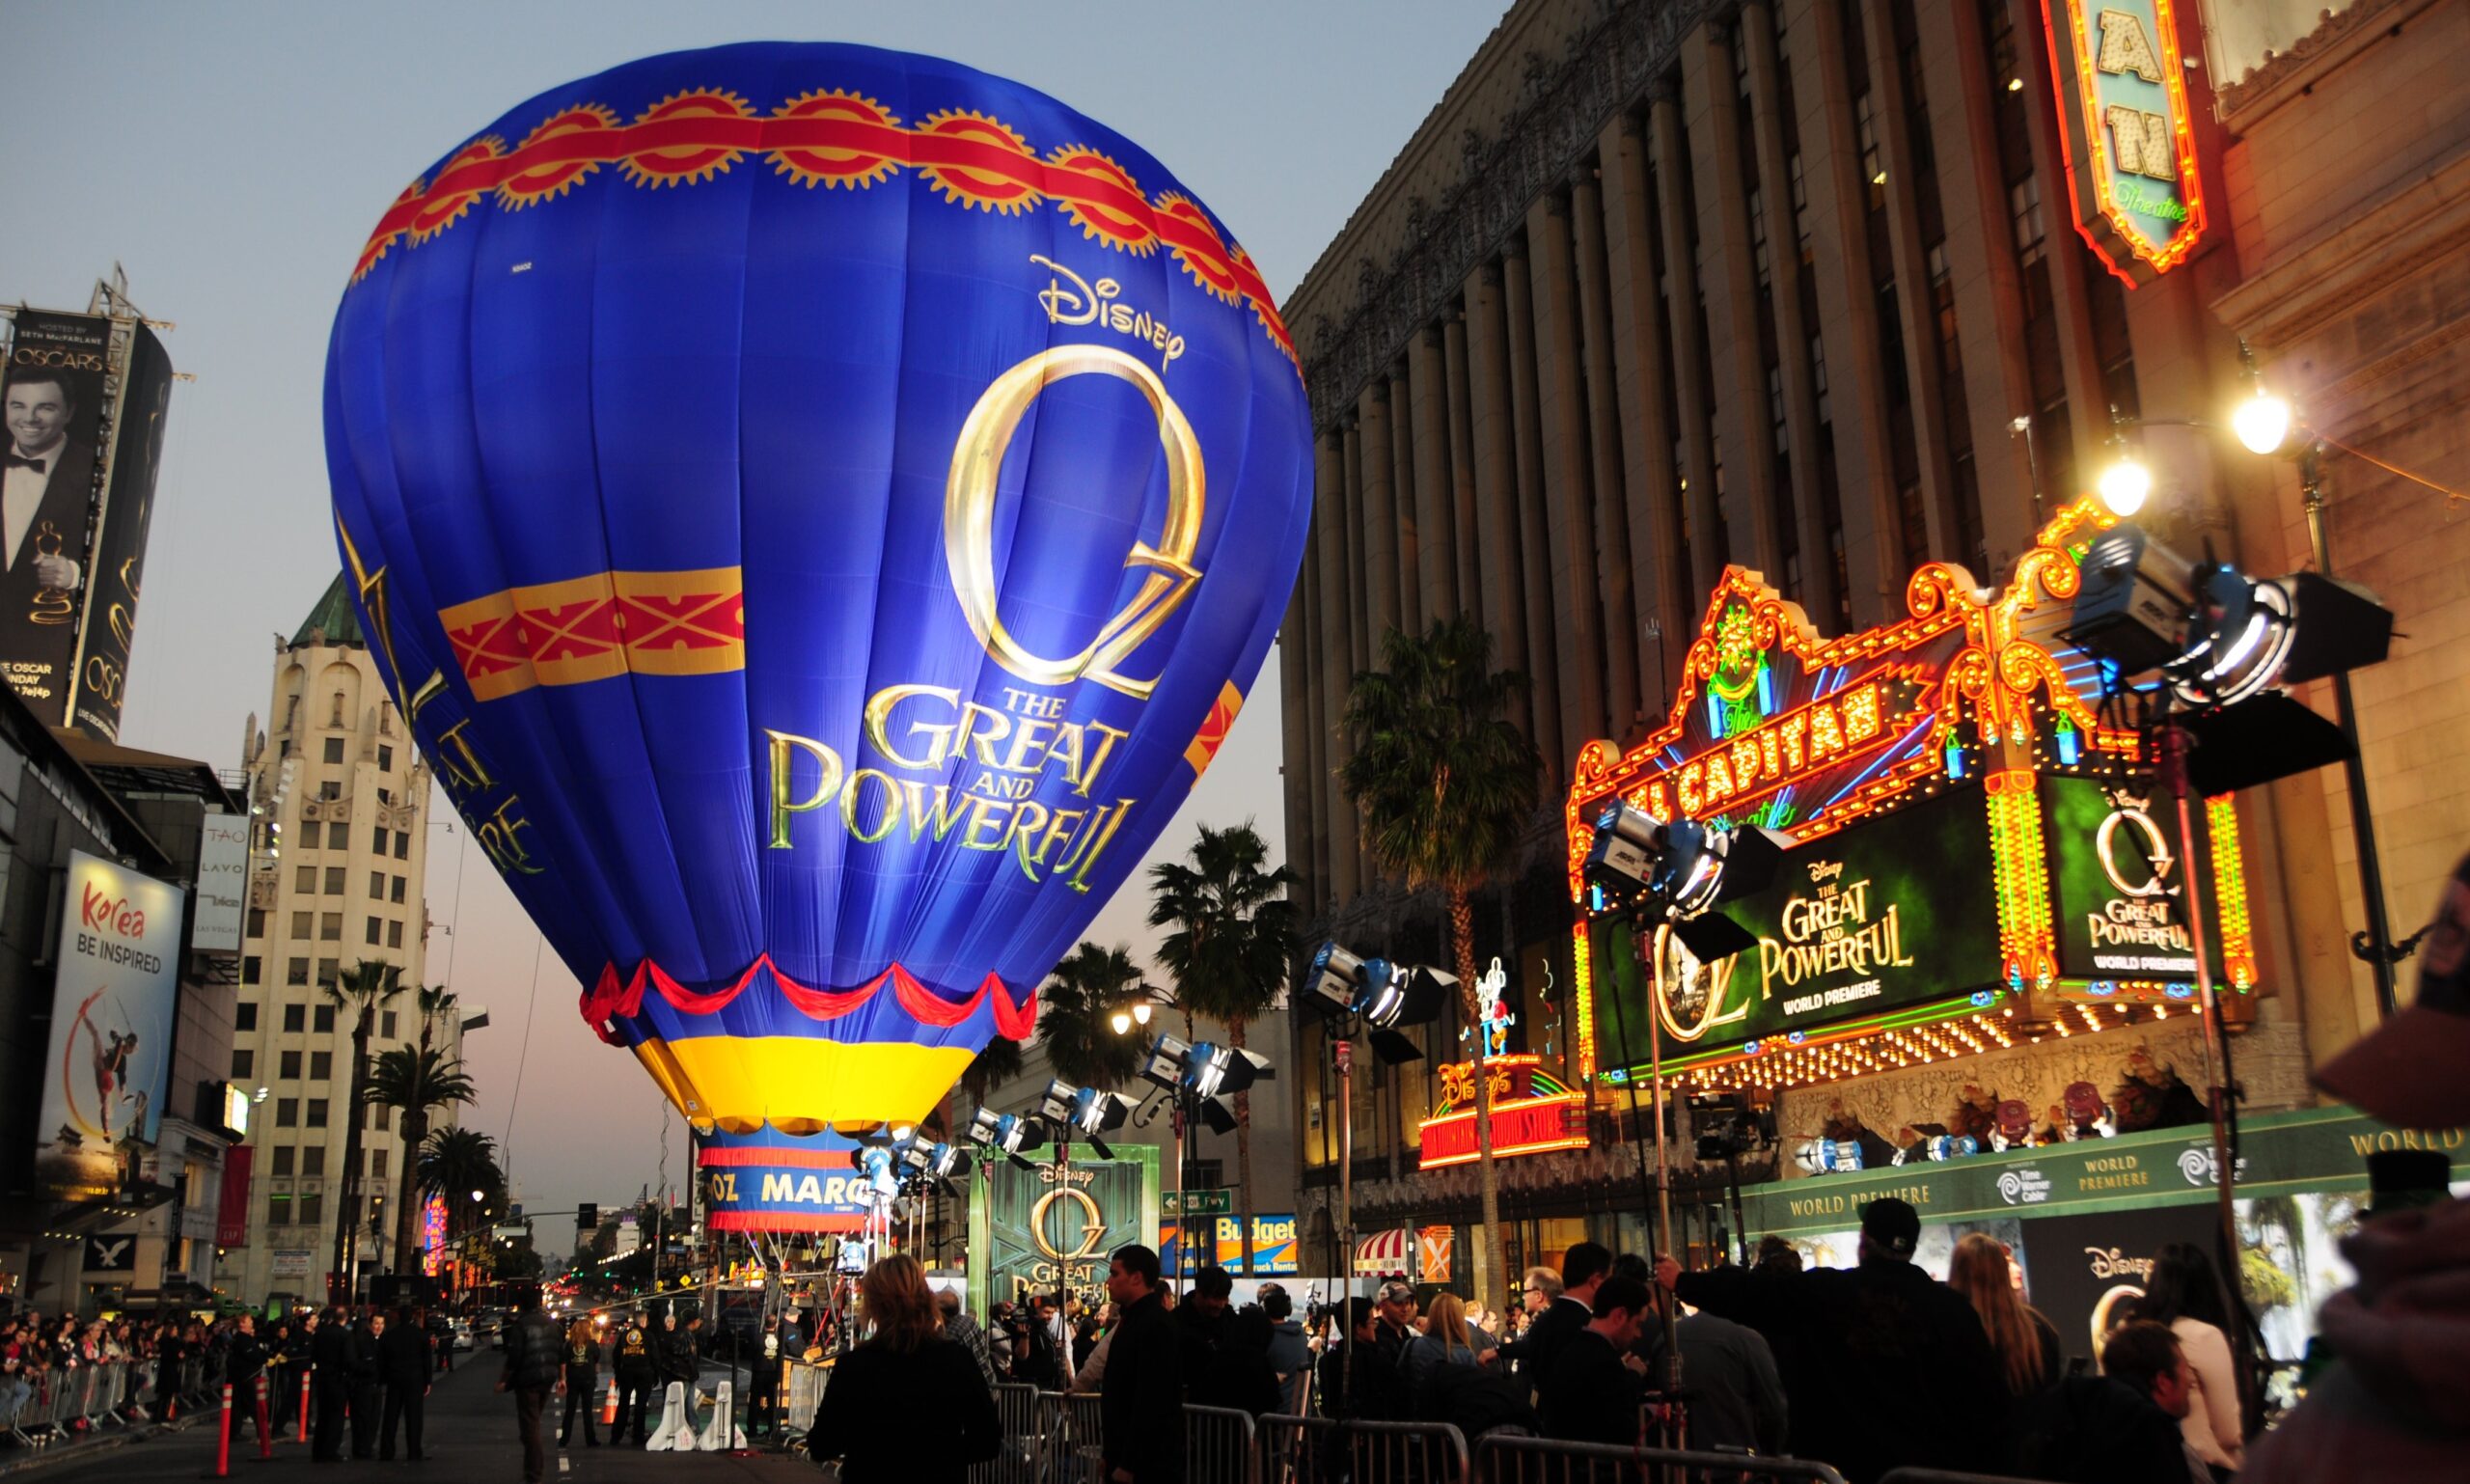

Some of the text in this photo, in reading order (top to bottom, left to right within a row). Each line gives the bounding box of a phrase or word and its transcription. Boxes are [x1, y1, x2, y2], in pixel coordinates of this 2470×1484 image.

[2114, 180, 2188, 223] Theatre
[1029, 255, 1186, 375] Disney
[40, 324, 73, 333] HOSTED
[14, 348, 103, 371] OSCARS
[9, 674, 41, 685] NDAY
[13, 663, 52, 674] OSCAR
[1002, 687, 1066, 720] THE
[1723, 701, 1759, 740] The
[864, 683, 1130, 798] GREAT
[1678, 682, 1880, 816] CAPITAN
[970, 771, 1034, 802] AND
[764, 726, 1139, 893] POWERFUL
[206, 829, 246, 843] TAO
[202, 863, 243, 873] LAVO
[1807, 860, 1844, 883] Disney
[1817, 882, 1838, 899] THE
[82, 880, 145, 941] Korea
[1781, 879, 1871, 944] GREAT
[2105, 898, 2170, 924] GREAT
[1821, 927, 1844, 945] AND
[2088, 913, 2195, 951] POWERFUL
[77, 933, 162, 975] BE INSPIRED
[1759, 903, 1914, 1001] POWERFUL
[2094, 955, 2140, 971] WORLD
[1783, 979, 1881, 1017] WORLD PREMIERE
[1490, 1113, 1523, 1149] TUDIO
[2349, 1127, 2465, 1157] WORLD
[1033, 1162, 1094, 1188] Disney
[2019, 1169, 2042, 1181] Time
[2085, 1155, 2138, 1173] WORLD
[760, 1174, 865, 1205] MARC
[2020, 1180, 2051, 1191] Warner
[2079, 1171, 2149, 1191] PREMIERE
[1204, 1196, 1225, 1208] Fwy
[1790, 1195, 1845, 1217] WORLD
[2021, 1191, 2047, 1202] Cable
[223, 1230, 238, 1242] GAP
[1252, 1262, 1272, 1273] ruck
[2084, 1247, 2155, 1284] Disney
